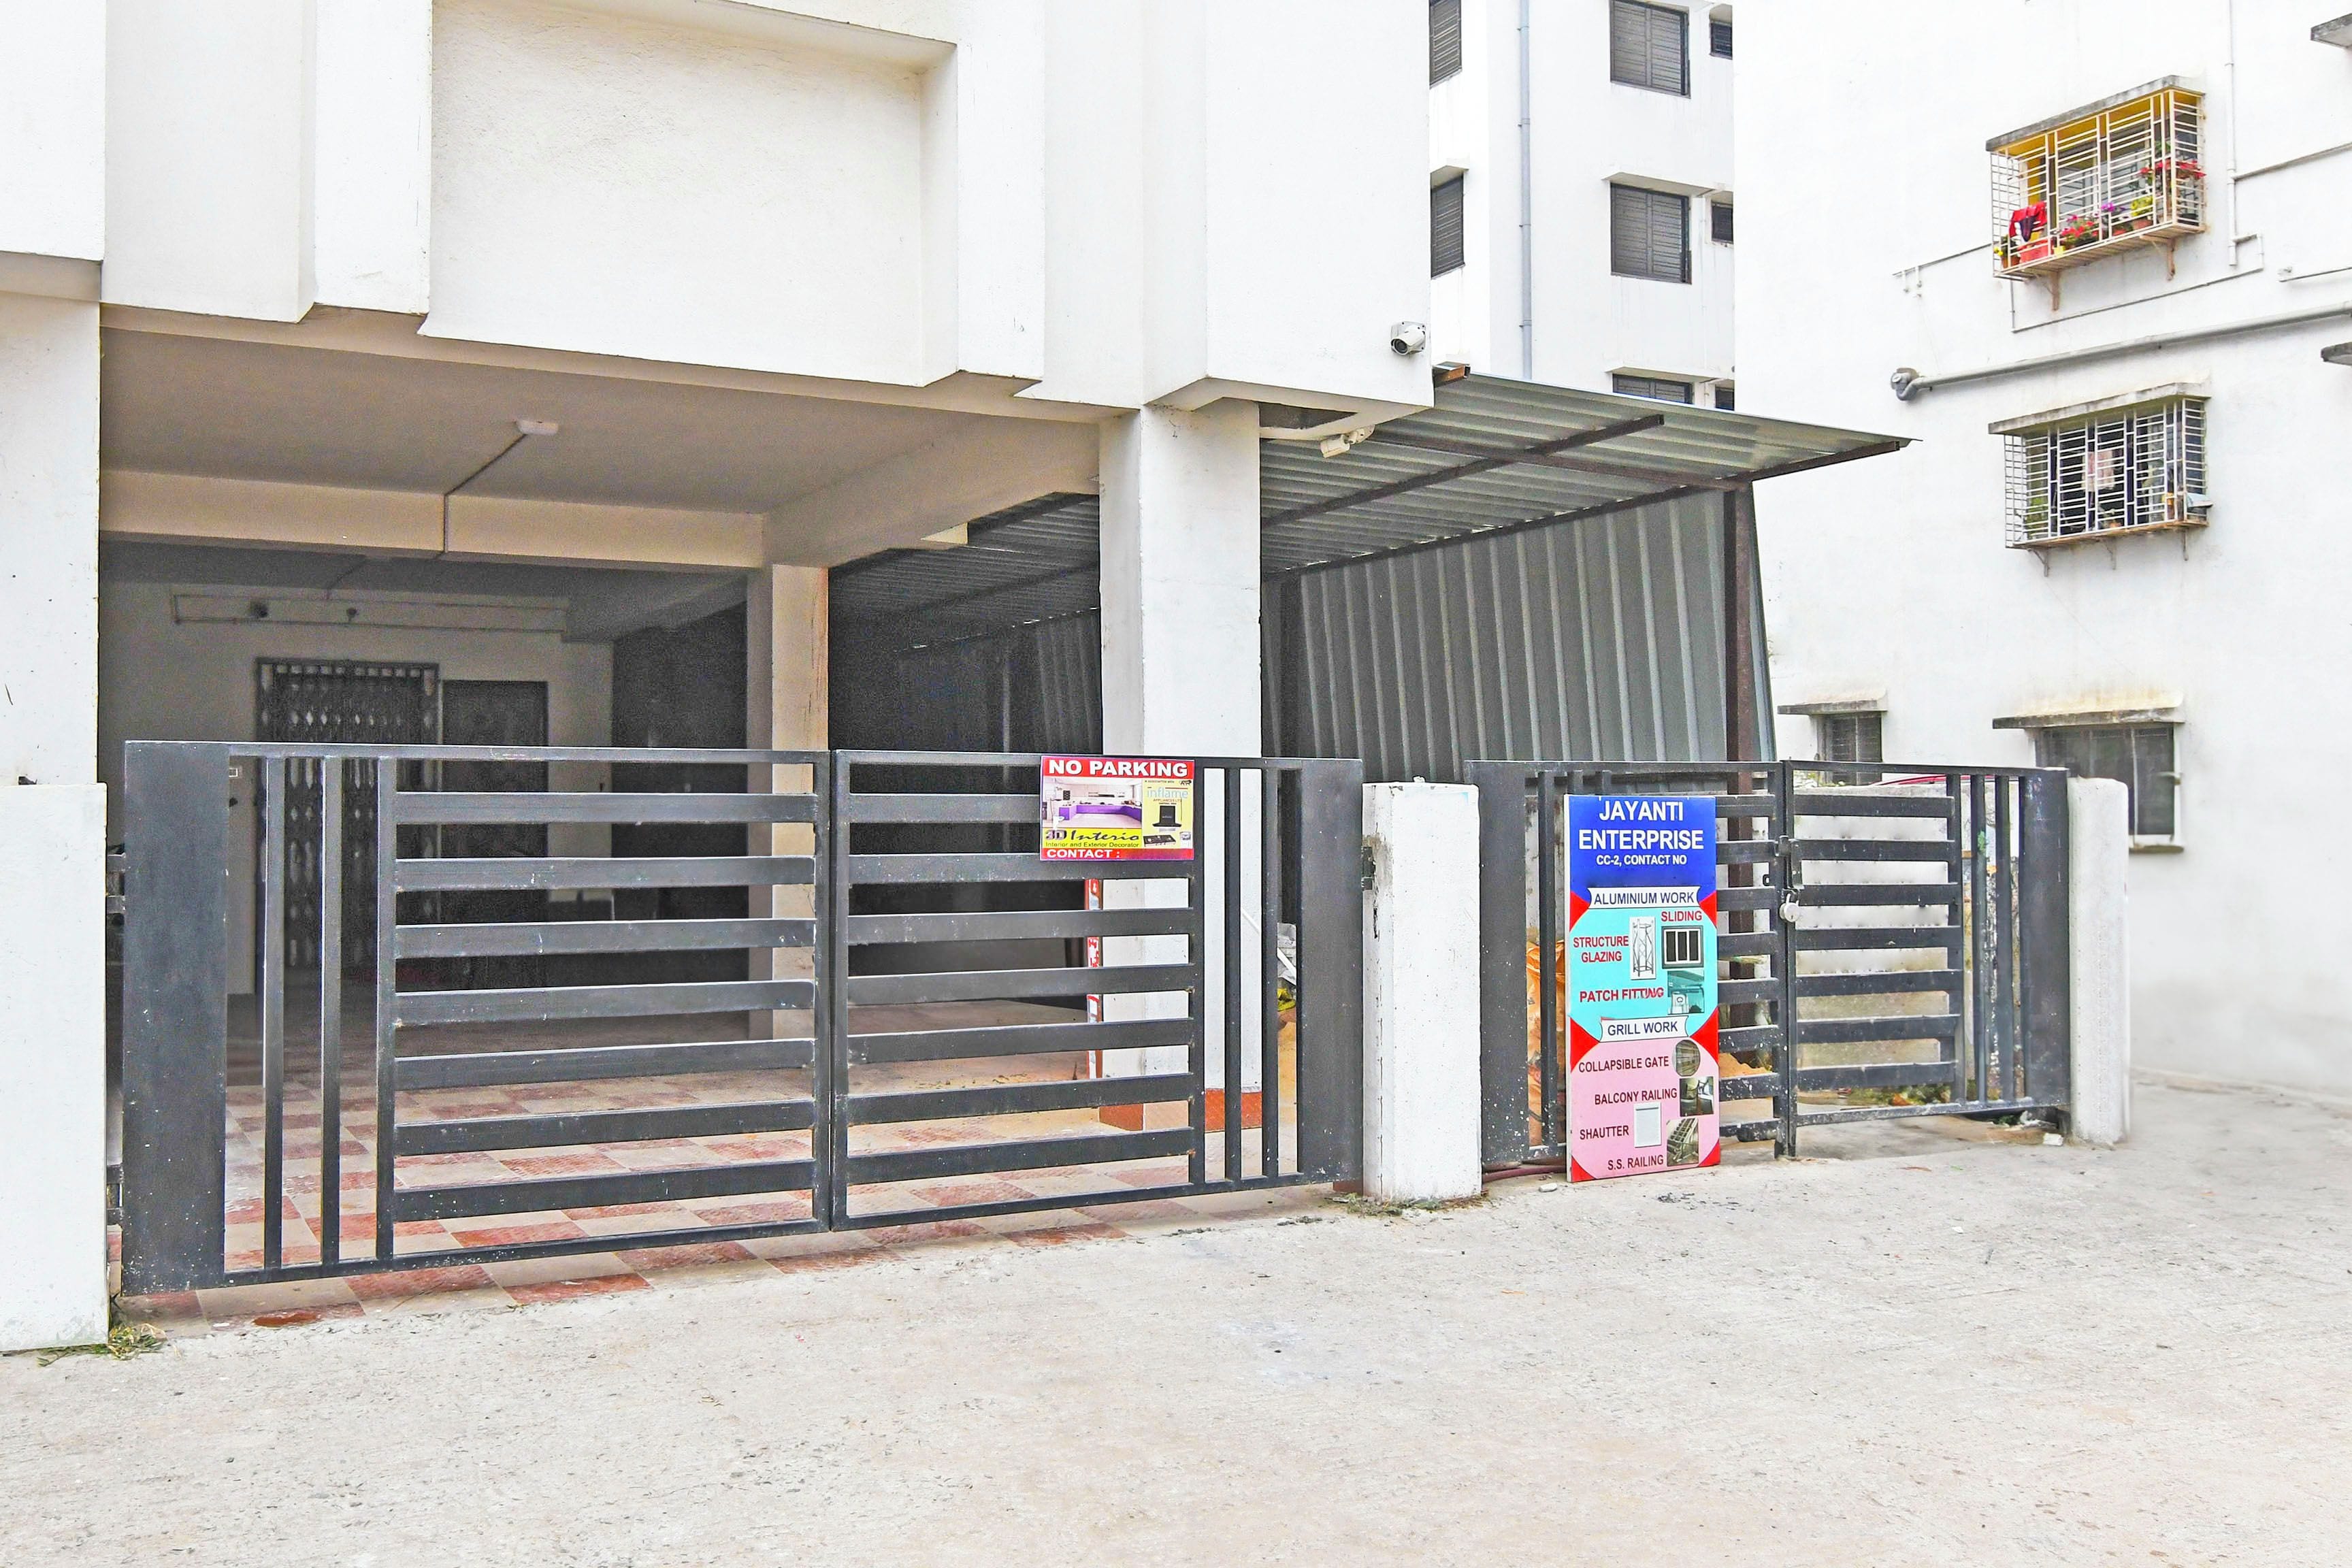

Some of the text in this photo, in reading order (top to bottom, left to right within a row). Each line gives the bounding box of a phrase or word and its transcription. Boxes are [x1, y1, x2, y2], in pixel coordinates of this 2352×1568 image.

[1049, 760, 1188, 777] NO PARKING
[1147, 787, 1188, 798] inflame
[1599, 801, 1683, 821] JAYANTI
[1071, 830, 1139, 840] Interio
[1578, 830, 1704, 850] ENTERPRISE
[1047, 849, 1113, 858] CONTACT
[1596, 854, 1687, 866] CC-2, CONTACT NO
[1594, 892, 1695, 904] ALUMINIUM WORK
[1661, 911, 1702, 921] SLIDING
[1573, 936, 1629, 947] STRUCTURE
[1581, 951, 1622, 963] GLAZING
[1580, 987, 1664, 1002] PATCH FITTING
[1607, 1022, 1678, 1036] GRILL WORK
[1578, 1056, 1669, 1073] COLLAPSIBLE GATE
[1595, 1088, 1678, 1105] BALCONY RAILING
[1580, 1125, 1629, 1140] SHAUTTER
[1607, 1154, 1664, 1171] S.S. RAILING
